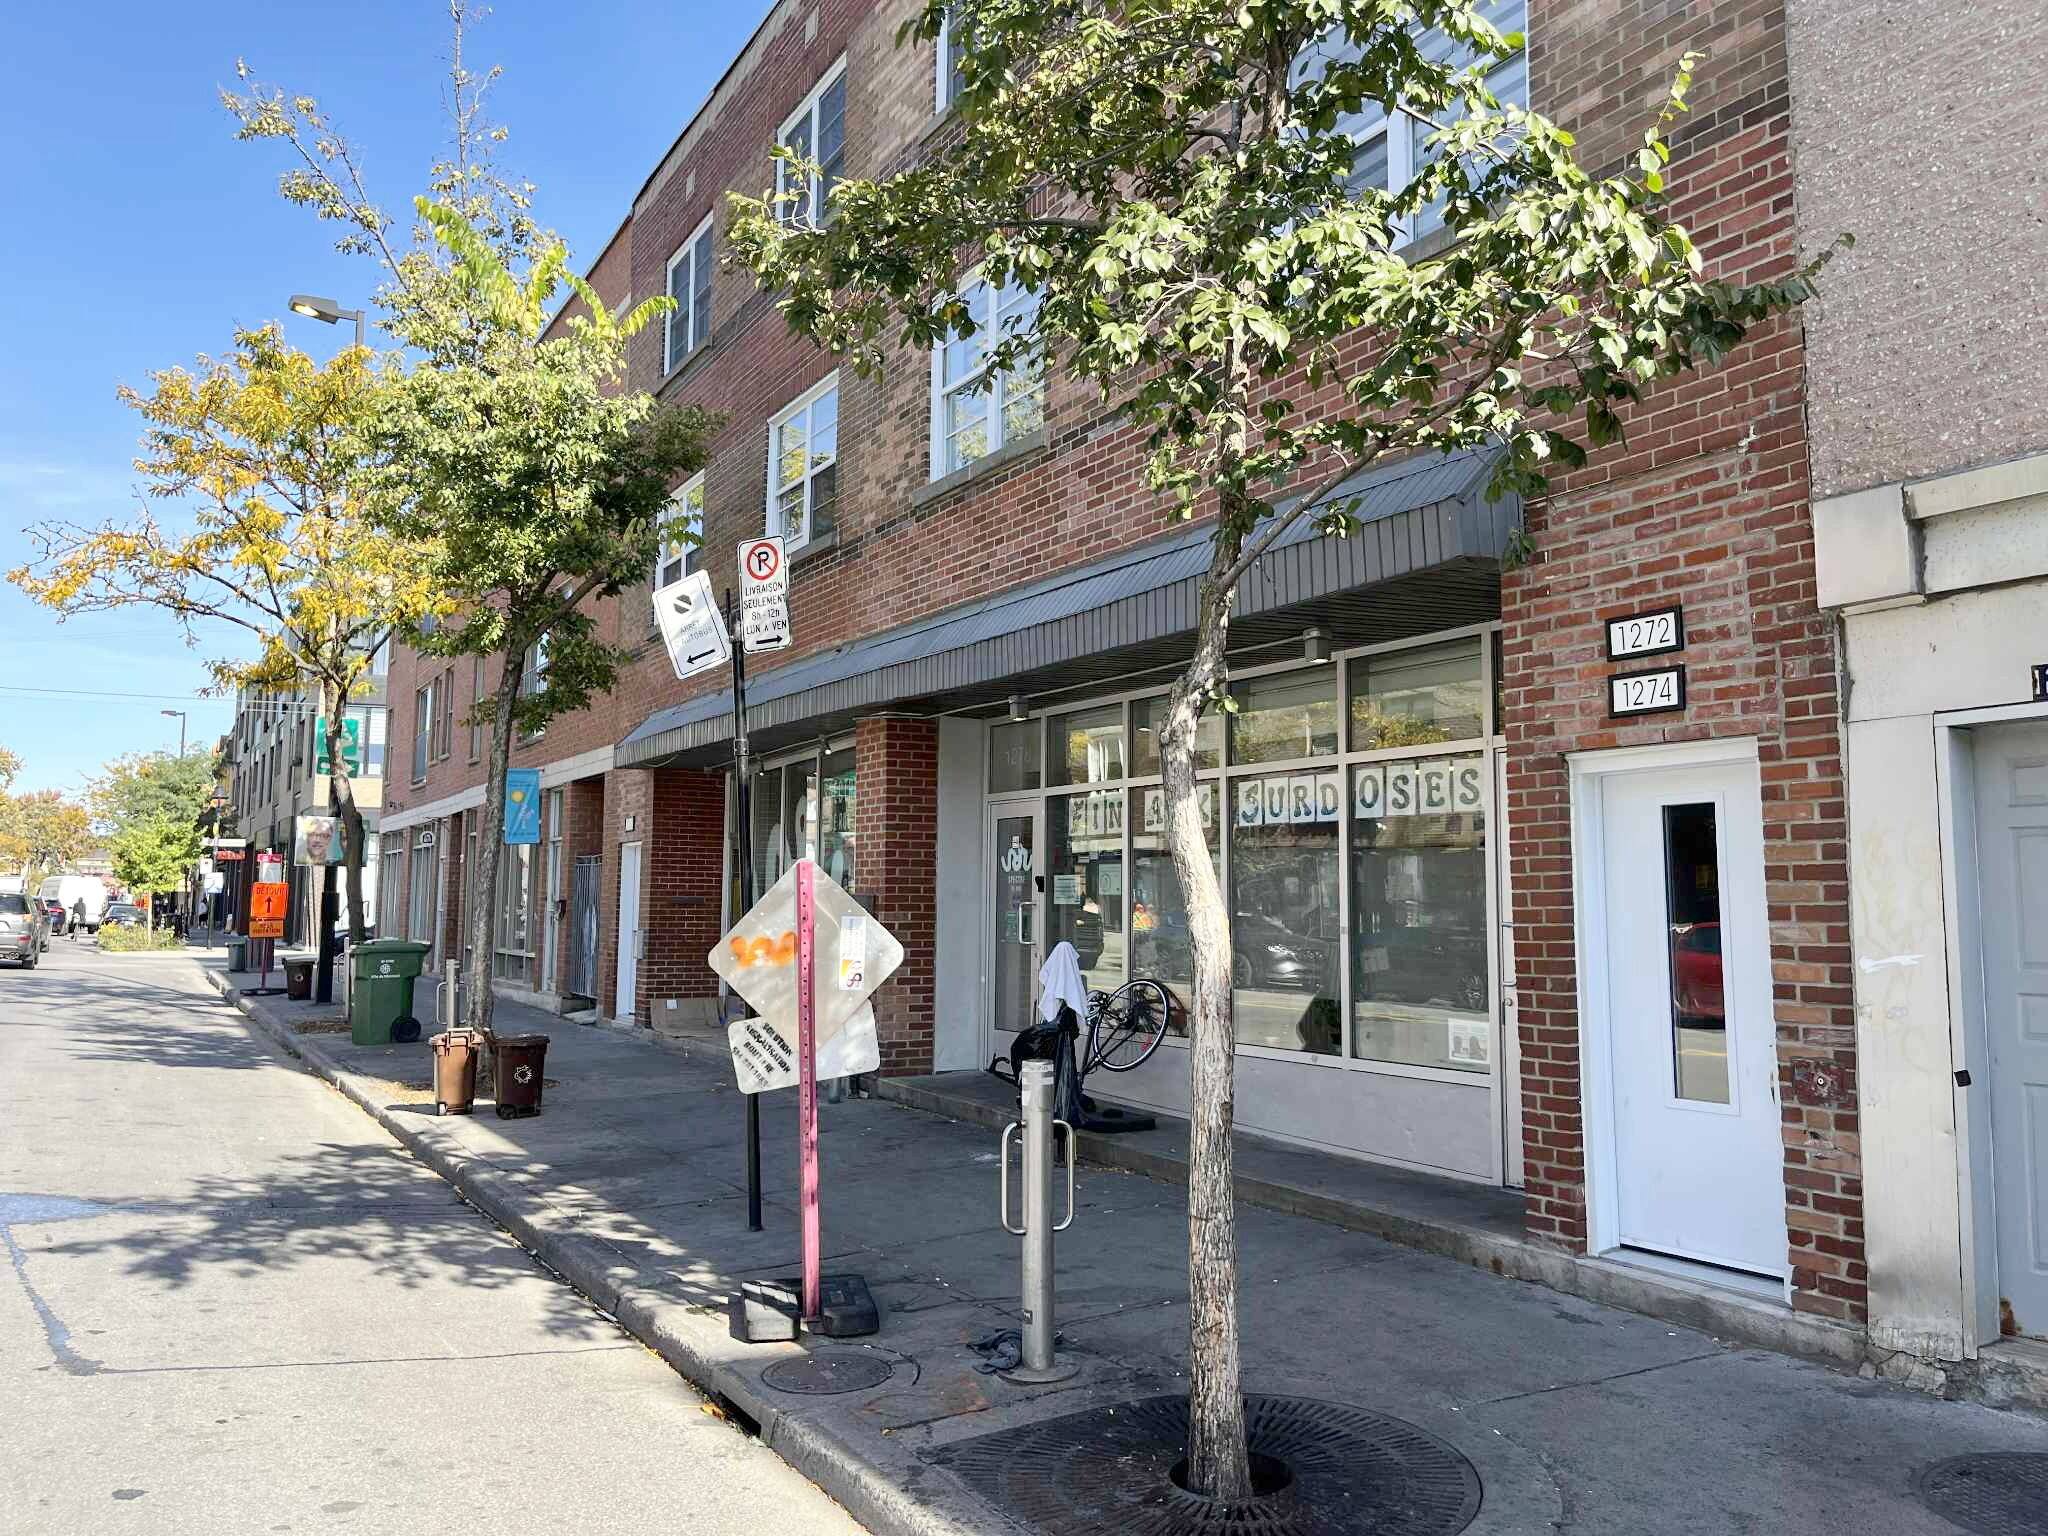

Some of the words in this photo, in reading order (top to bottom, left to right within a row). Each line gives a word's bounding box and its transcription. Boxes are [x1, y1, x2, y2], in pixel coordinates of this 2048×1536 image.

[743, 593, 785, 610] SEULEMENT
[745, 582, 783, 597] LIVRAISON
[746, 625, 761, 635] LUN
[772, 620, 787, 631] VEN
[1618, 617, 1670, 651] 1272
[1623, 676, 1672, 708] 1274
[1240, 767, 1482, 824] SURDOSES
